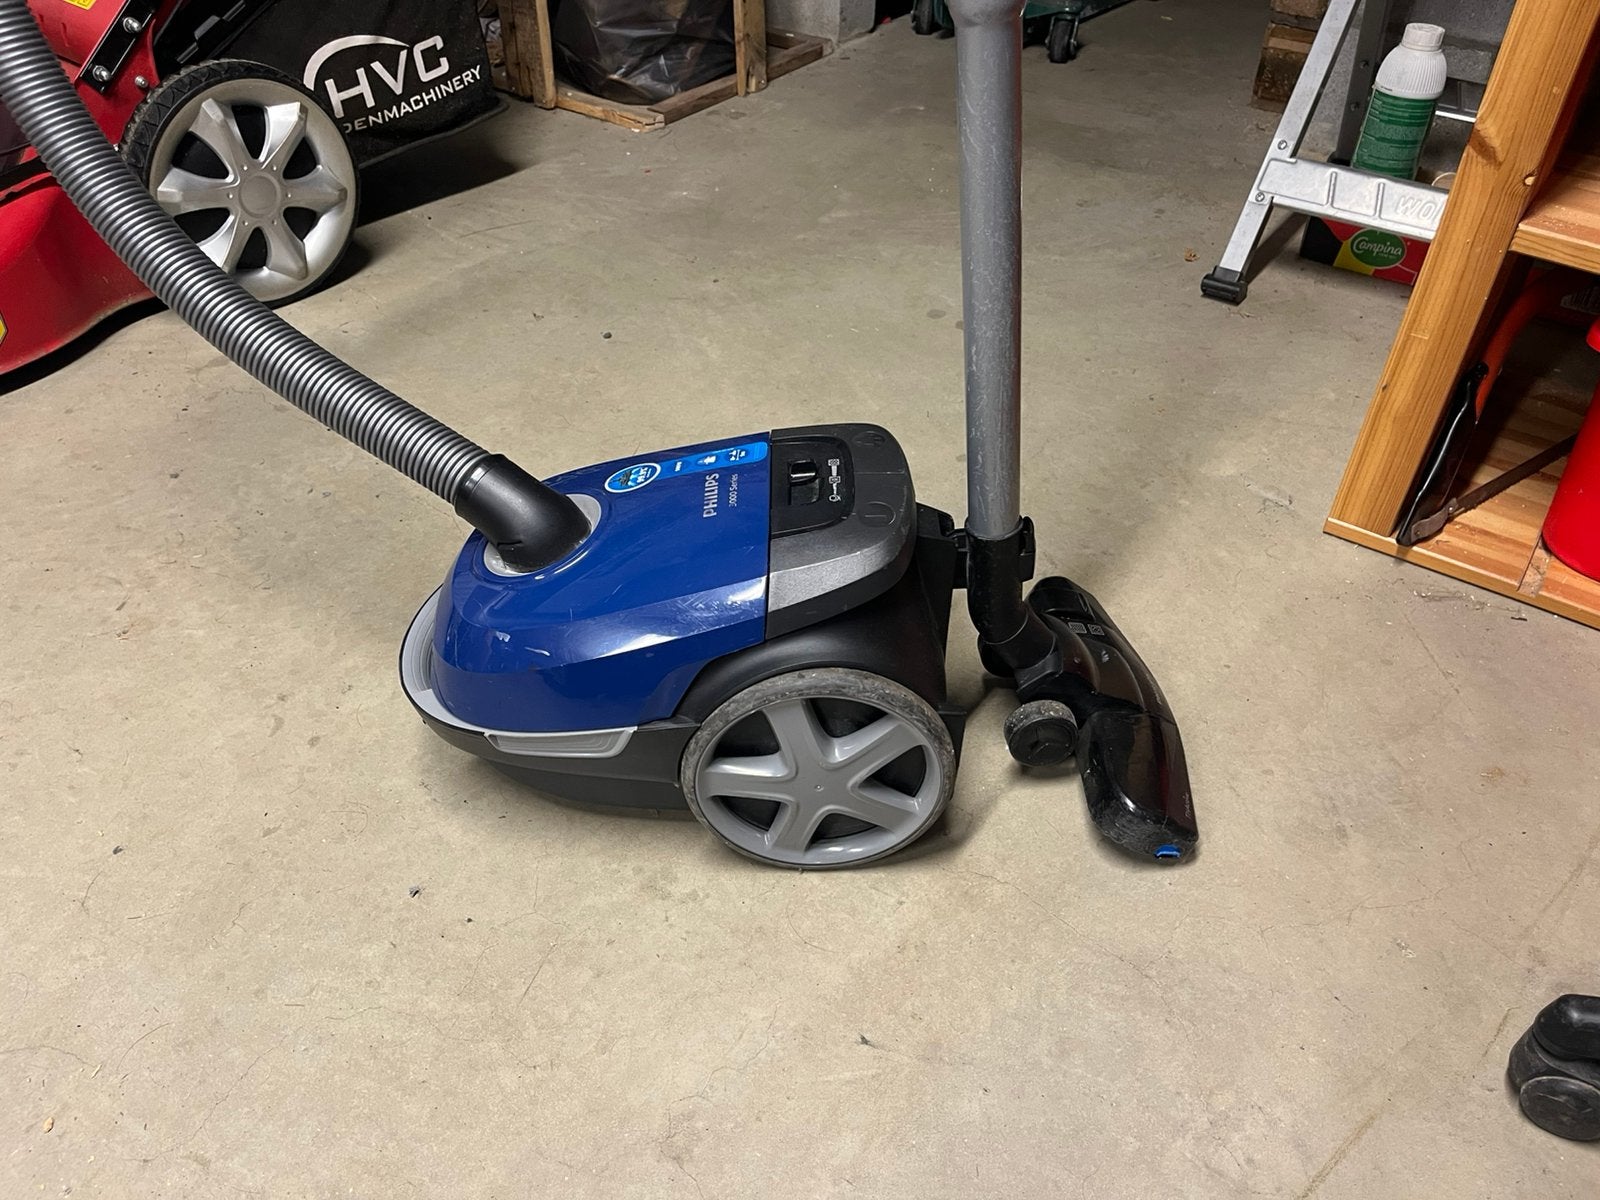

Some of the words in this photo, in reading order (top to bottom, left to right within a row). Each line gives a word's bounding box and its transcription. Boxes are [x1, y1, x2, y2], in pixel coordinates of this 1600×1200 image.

[324, 35, 449, 119] HVC
[1395, 195, 1443, 223] WO
[1352, 236, 1403, 258] Campina
[729, 473, 739, 491] Series
[702, 473, 720, 518] PHILIPS
[728, 490, 738, 508] 3000
